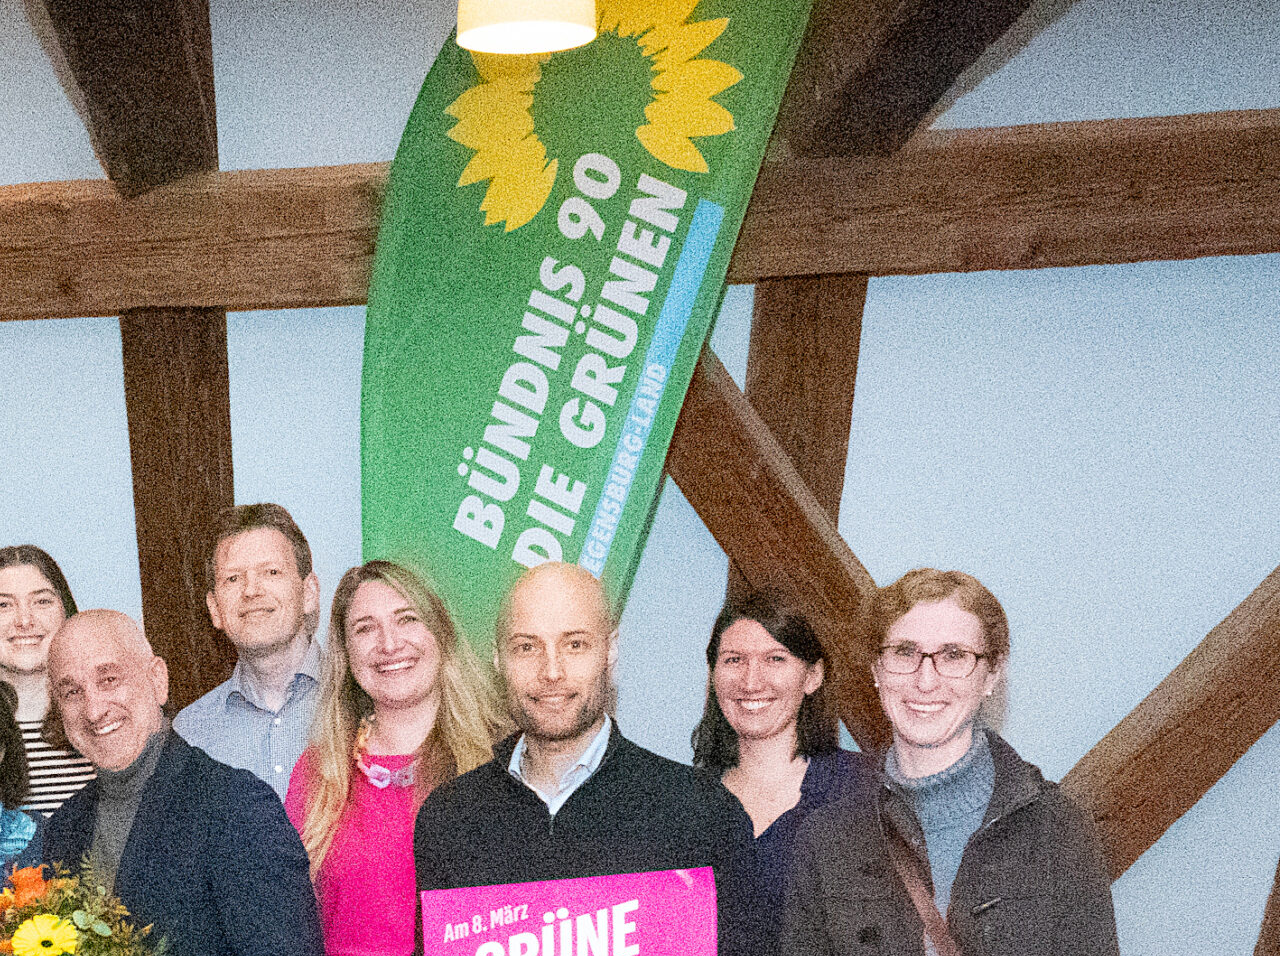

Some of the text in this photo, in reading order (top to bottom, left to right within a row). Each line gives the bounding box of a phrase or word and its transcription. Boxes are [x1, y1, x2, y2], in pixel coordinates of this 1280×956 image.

[453, 153, 620, 549] BÜNDNIS 90
[511, 173, 687, 569] DIE GRÜNEN
[583, 362, 666, 573] EGENSBURG-LAND
[443, 904, 530, 943] Am 8. März
